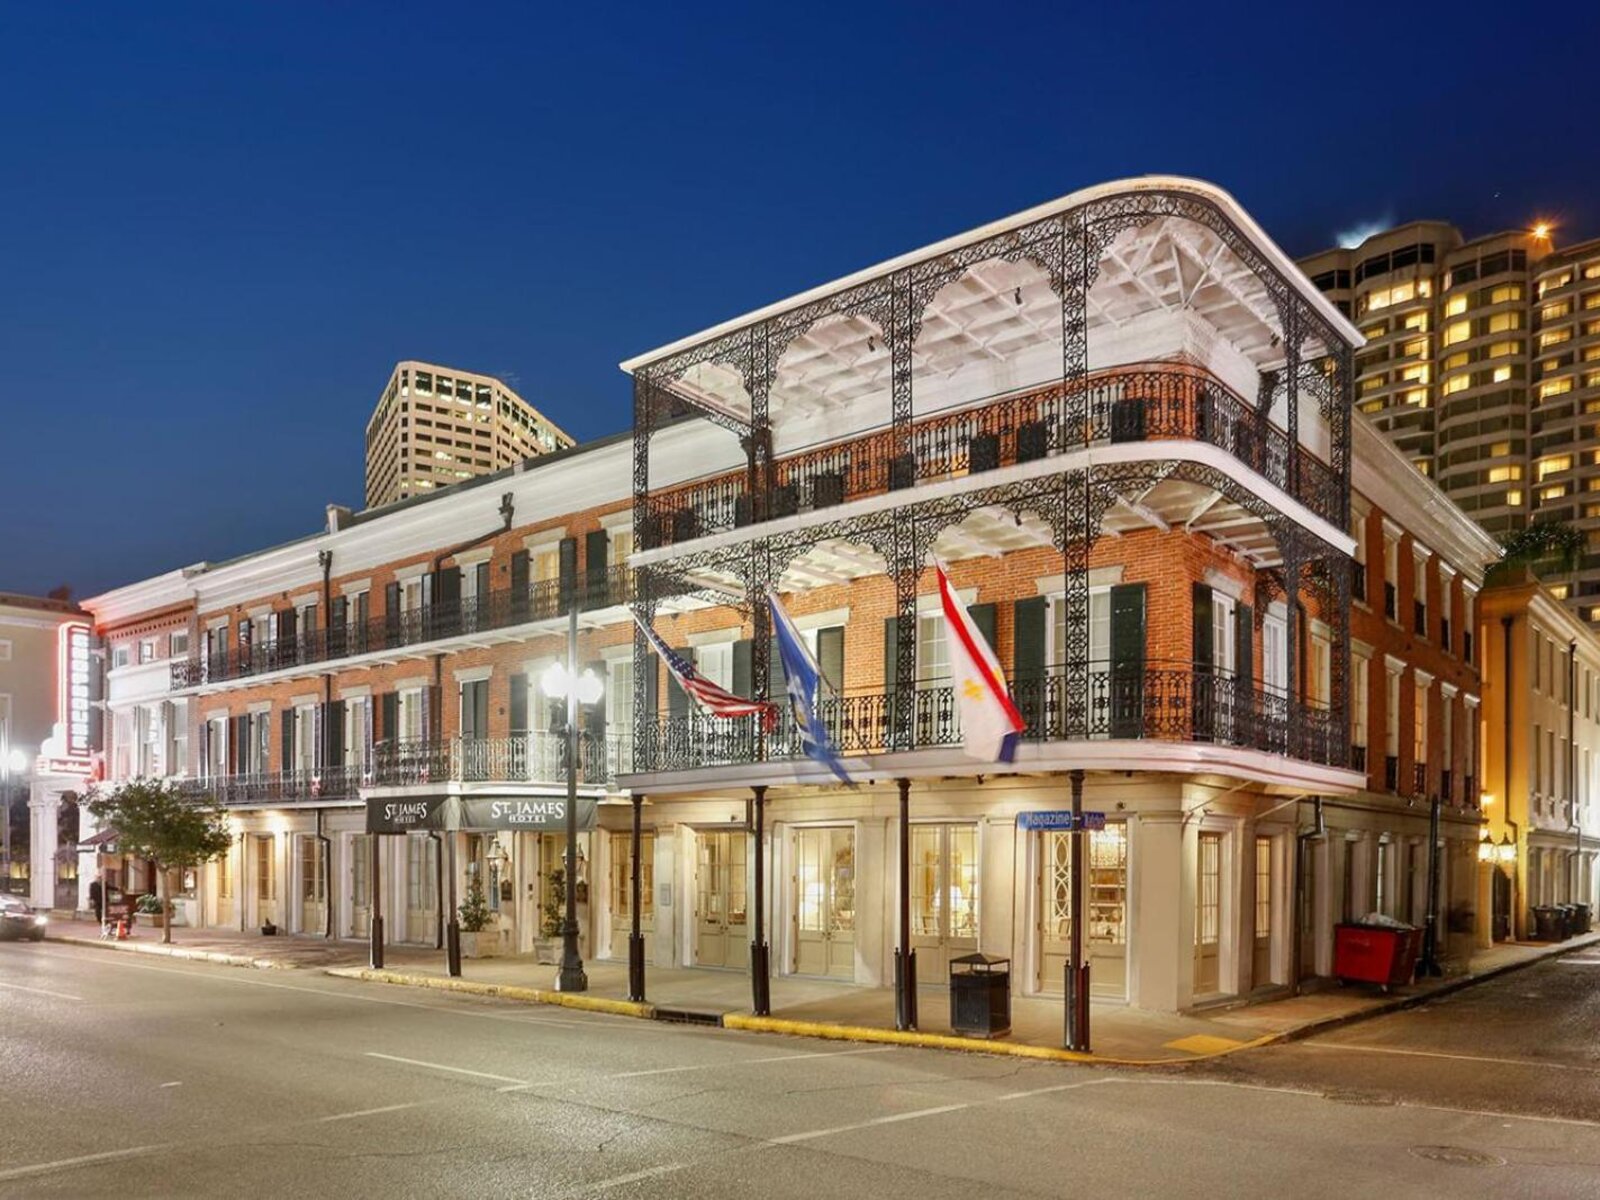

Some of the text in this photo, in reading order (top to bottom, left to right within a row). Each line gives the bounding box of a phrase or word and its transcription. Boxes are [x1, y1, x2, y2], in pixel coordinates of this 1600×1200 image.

[399, 801, 427, 819] JAMES
[491, 801, 565, 820] ST. JAMES
[508, 815, 547, 823] HOTEL
